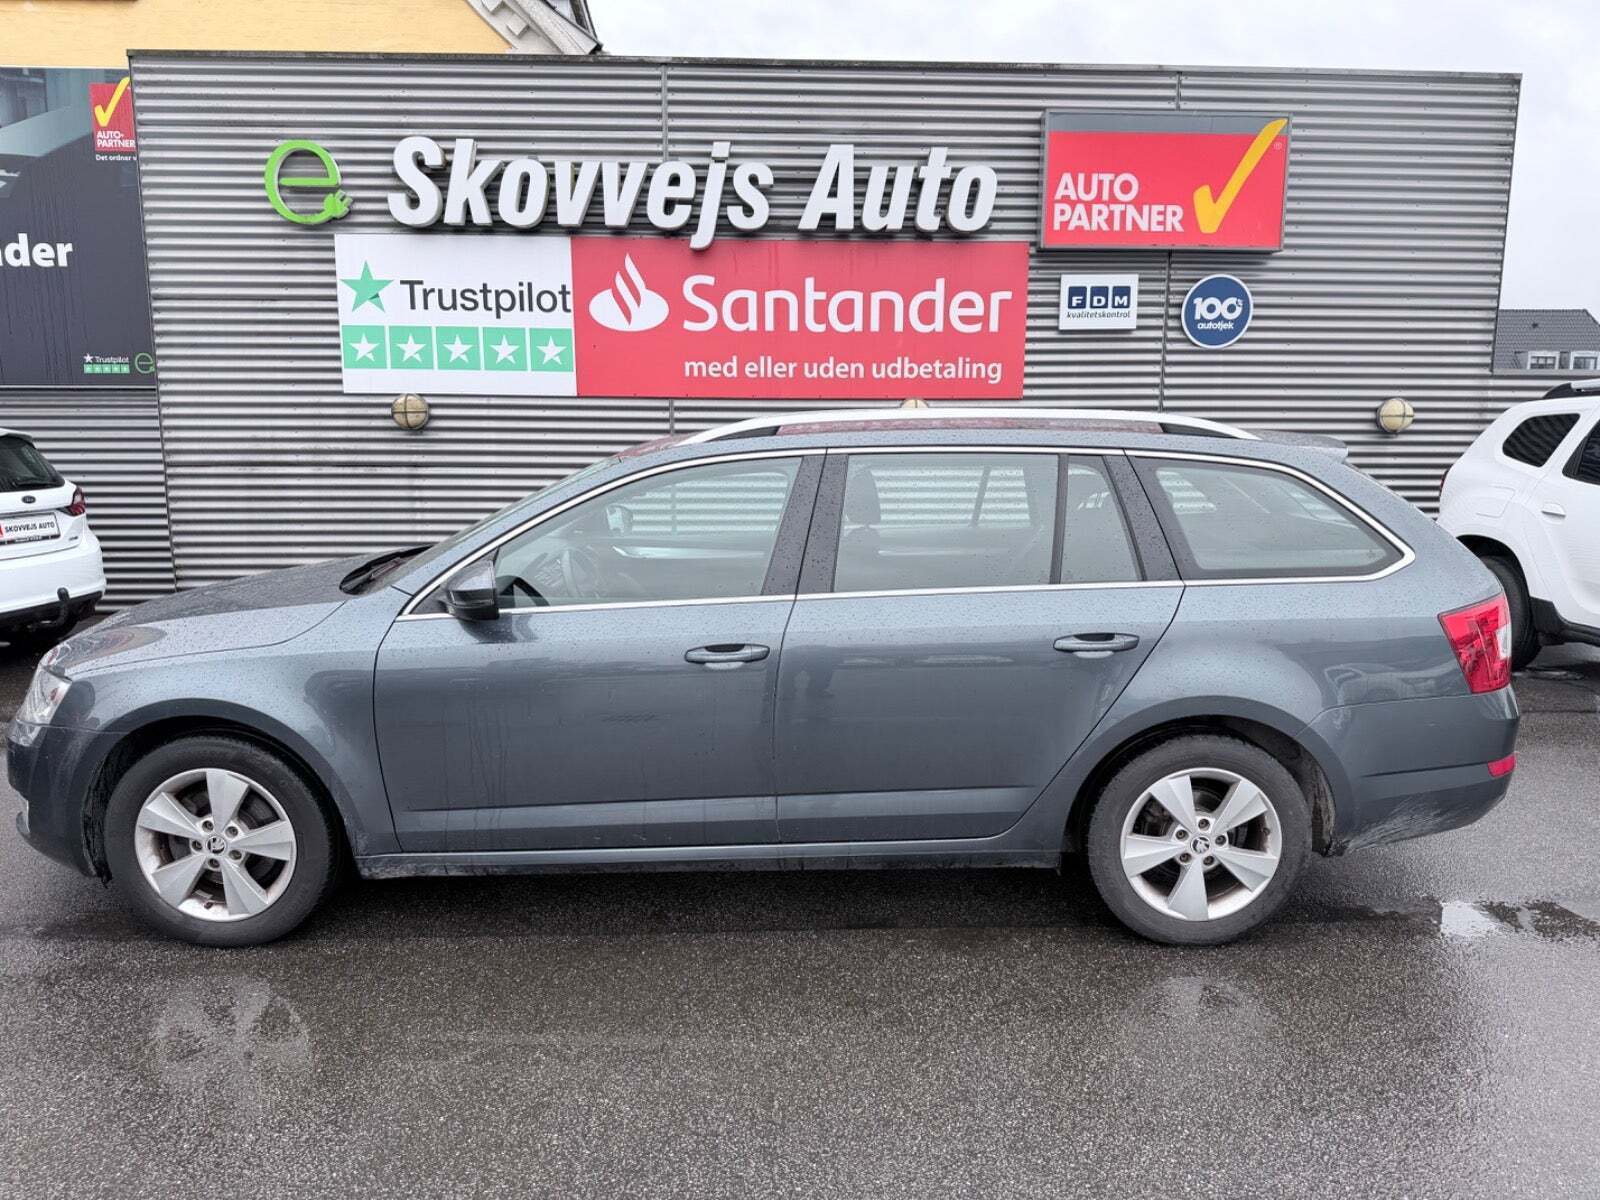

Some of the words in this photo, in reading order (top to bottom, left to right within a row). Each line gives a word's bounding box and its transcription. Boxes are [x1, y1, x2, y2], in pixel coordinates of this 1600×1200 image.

[387, 135, 774, 250] Skovvejs
[798, 143, 997, 233] Auto
[1054, 172, 1139, 201] AUTO
[1053, 203, 1184, 232] PARTNER
[0, 233, 73, 267] der
[400, 280, 571, 319] Trustpilot
[682, 275, 1012, 333] Santander
[1071, 296, 1128, 307] FDM
[1067, 310, 1130, 319] kvalitetskontrol
[1198, 321, 1234, 331] autotjek
[684, 356, 737, 378] med
[745, 357, 797, 378] eller
[804, 357, 865, 378] uden
[872, 358, 1002, 384] udbetaling
